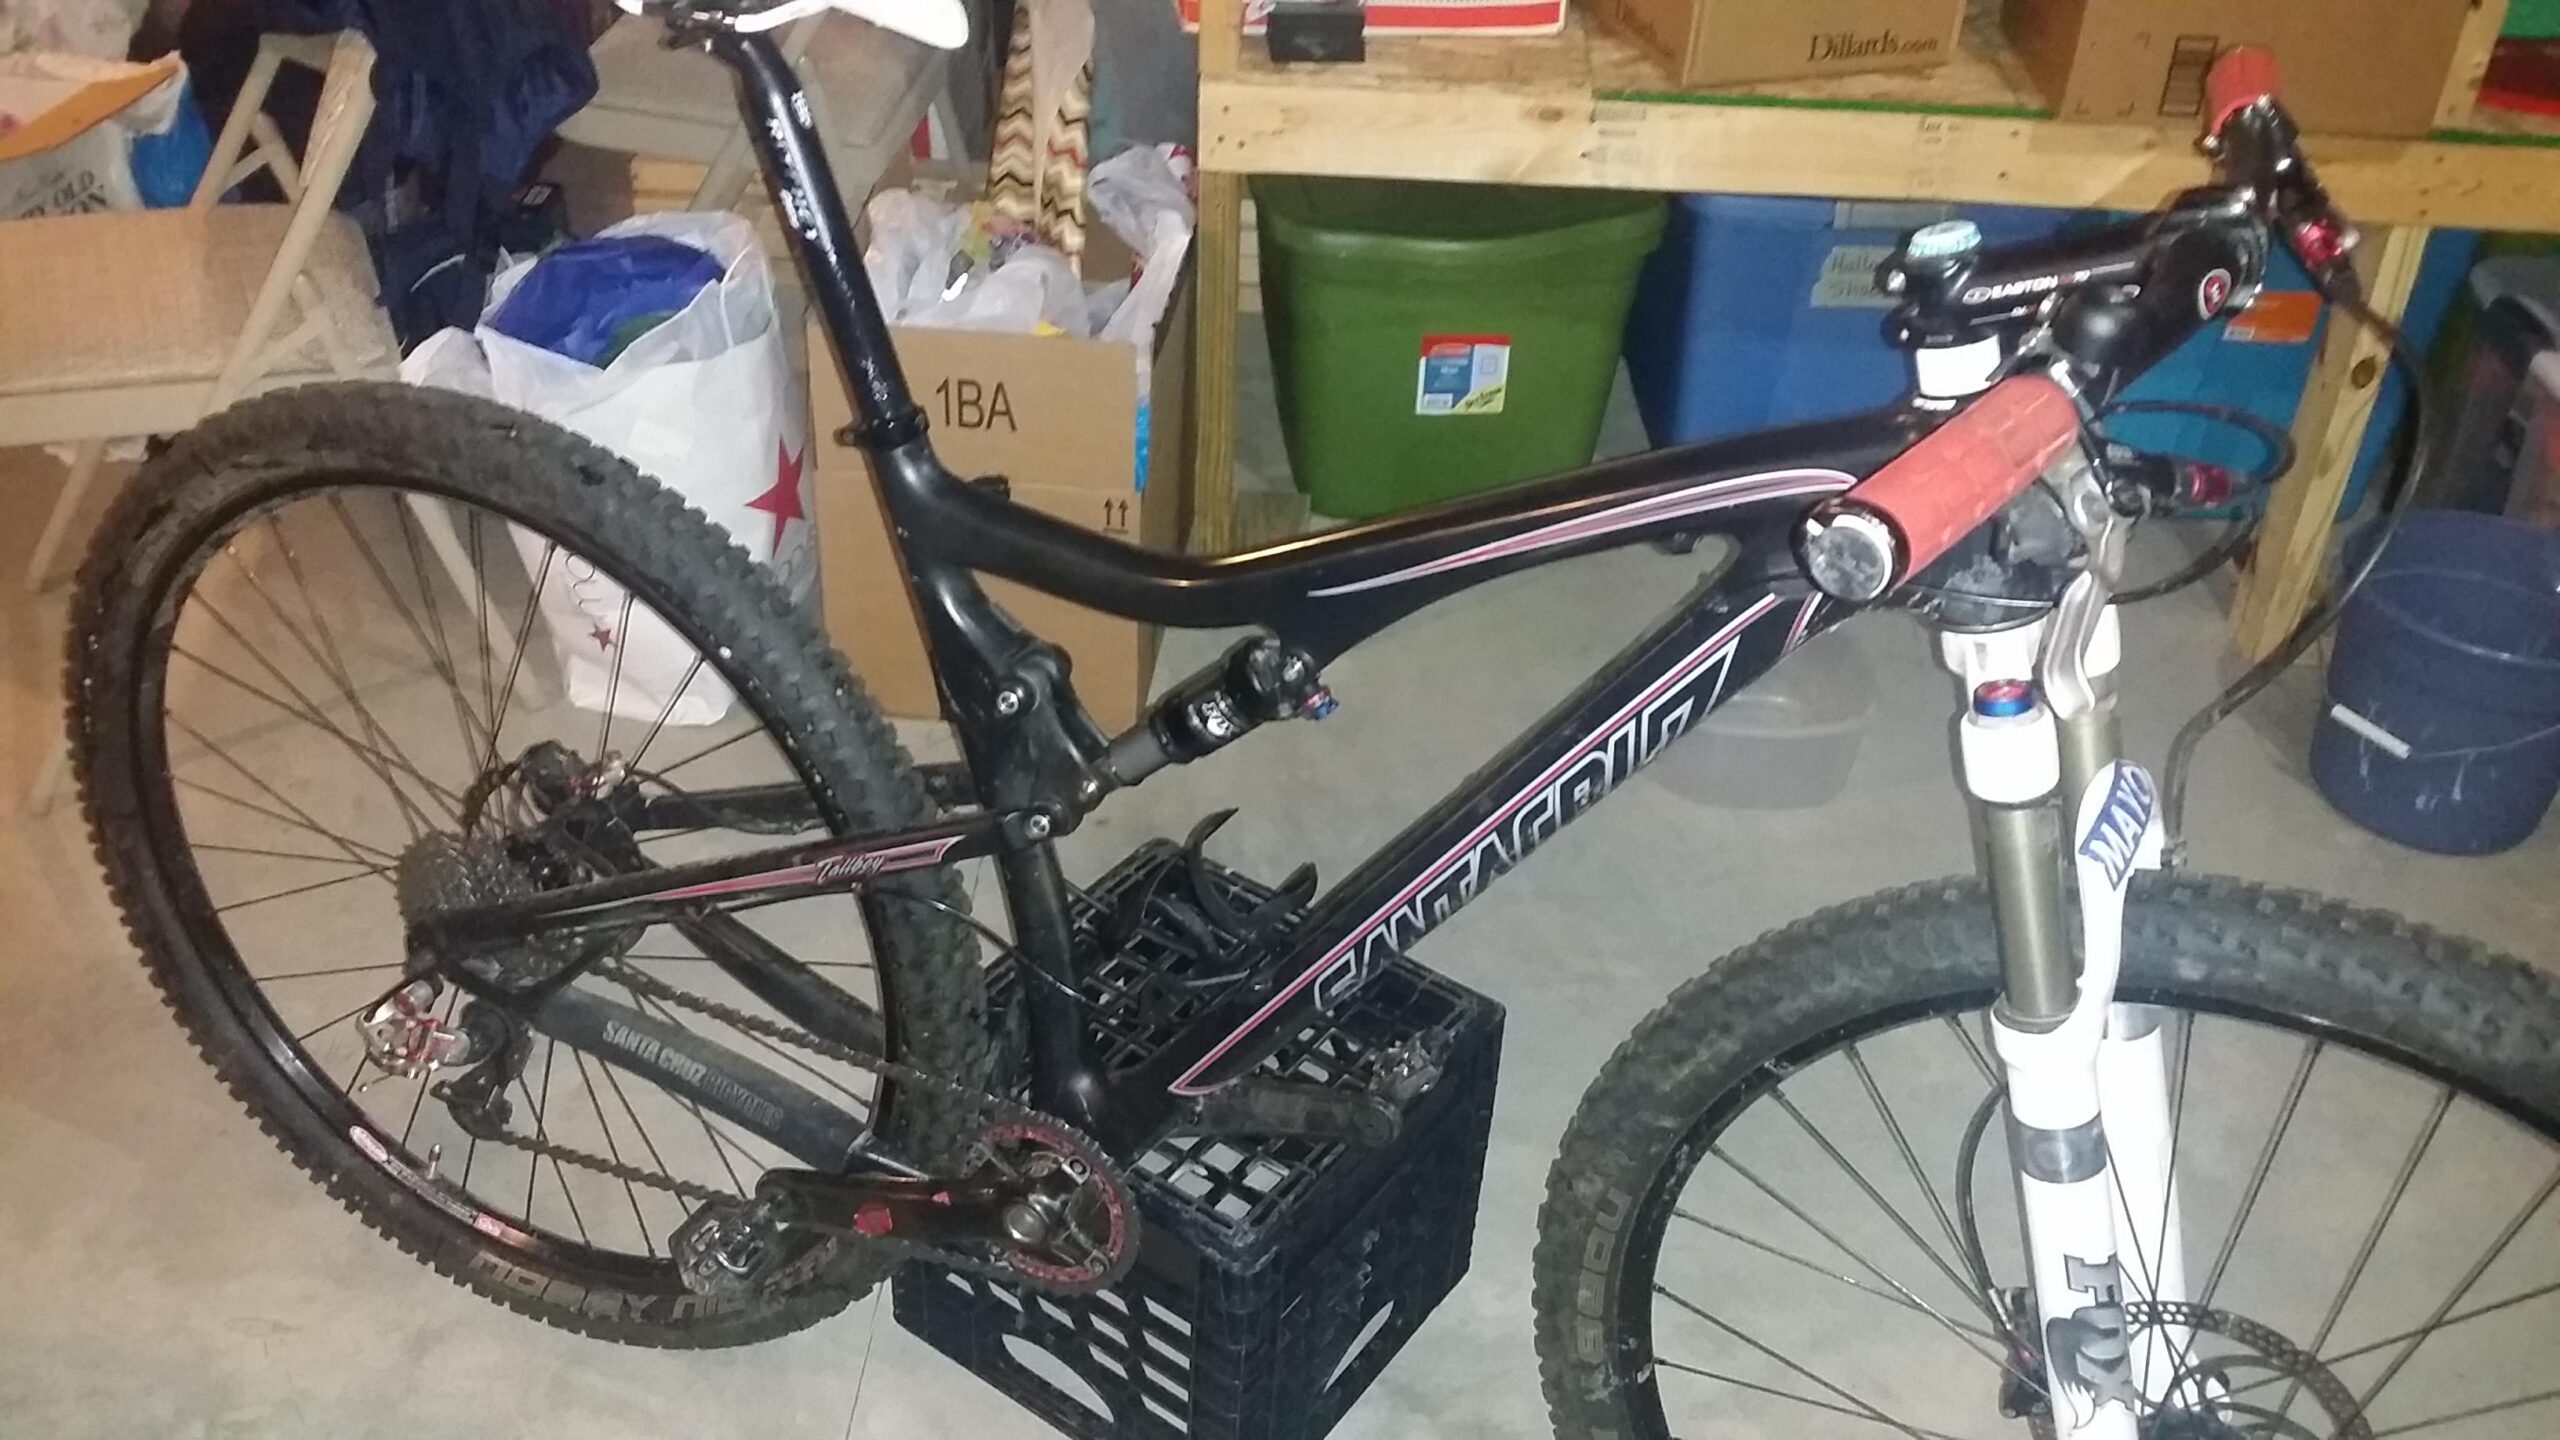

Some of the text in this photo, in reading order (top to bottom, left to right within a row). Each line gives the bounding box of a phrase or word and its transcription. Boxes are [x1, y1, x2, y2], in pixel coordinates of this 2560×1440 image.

[1990, 275, 2059, 300] EASTON
[936, 377, 1018, 432] 1BA
[817, 855, 885, 884] Tallboy
[602, 1019, 661, 1063] SANTA
[658, 1047, 708, 1088] CRUZ
